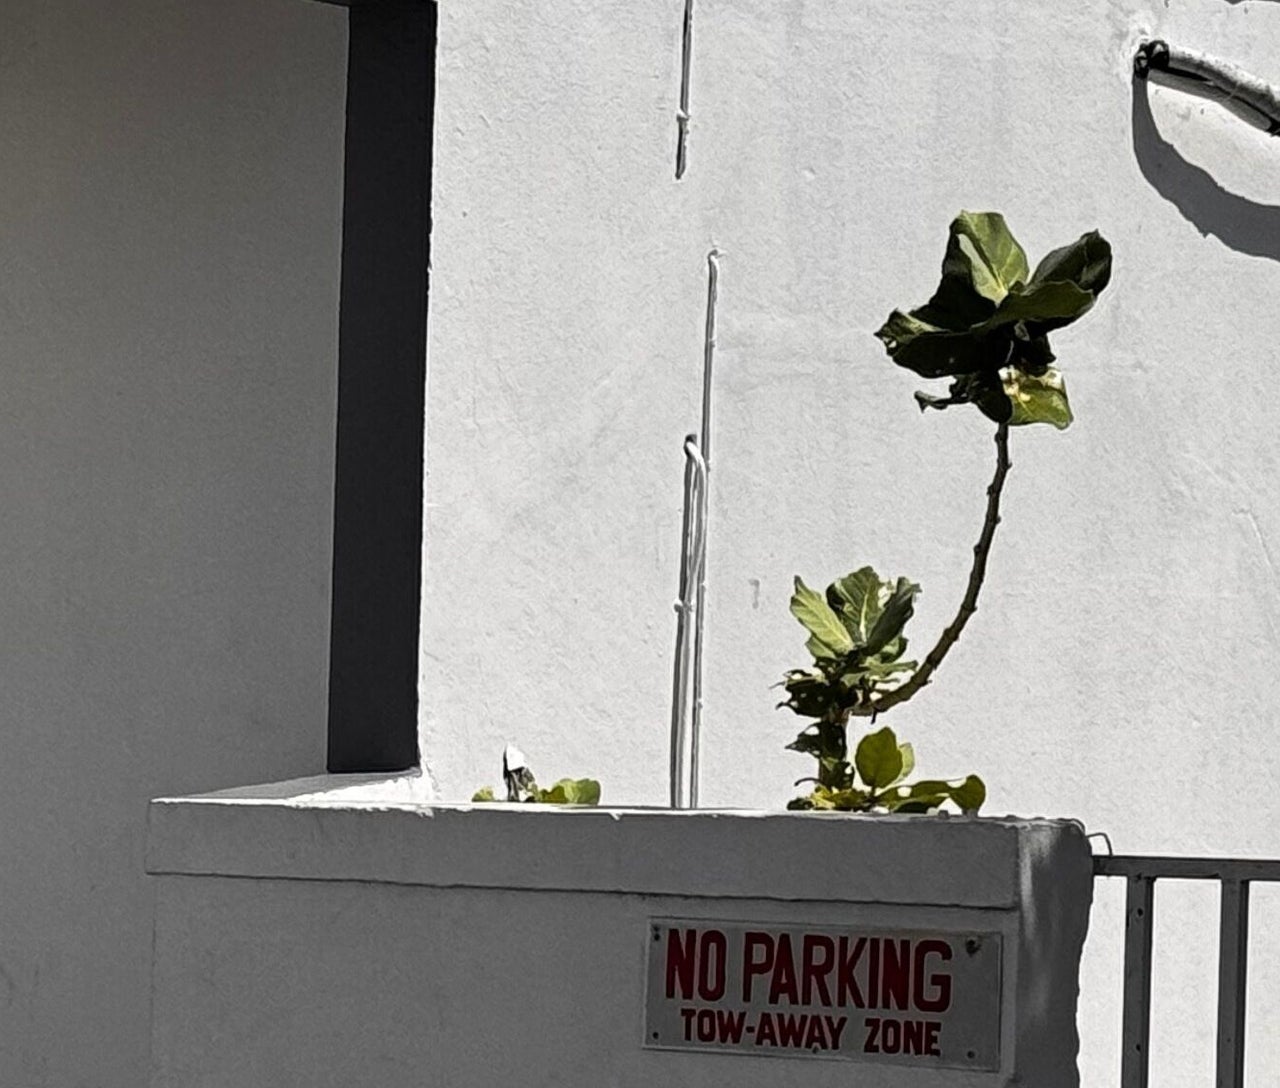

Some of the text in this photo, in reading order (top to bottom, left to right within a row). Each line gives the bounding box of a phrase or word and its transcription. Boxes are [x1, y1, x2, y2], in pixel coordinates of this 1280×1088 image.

[666, 929, 953, 1013] NO PARKING
[681, 1008, 942, 1056] TOW-AWAY ZONE
